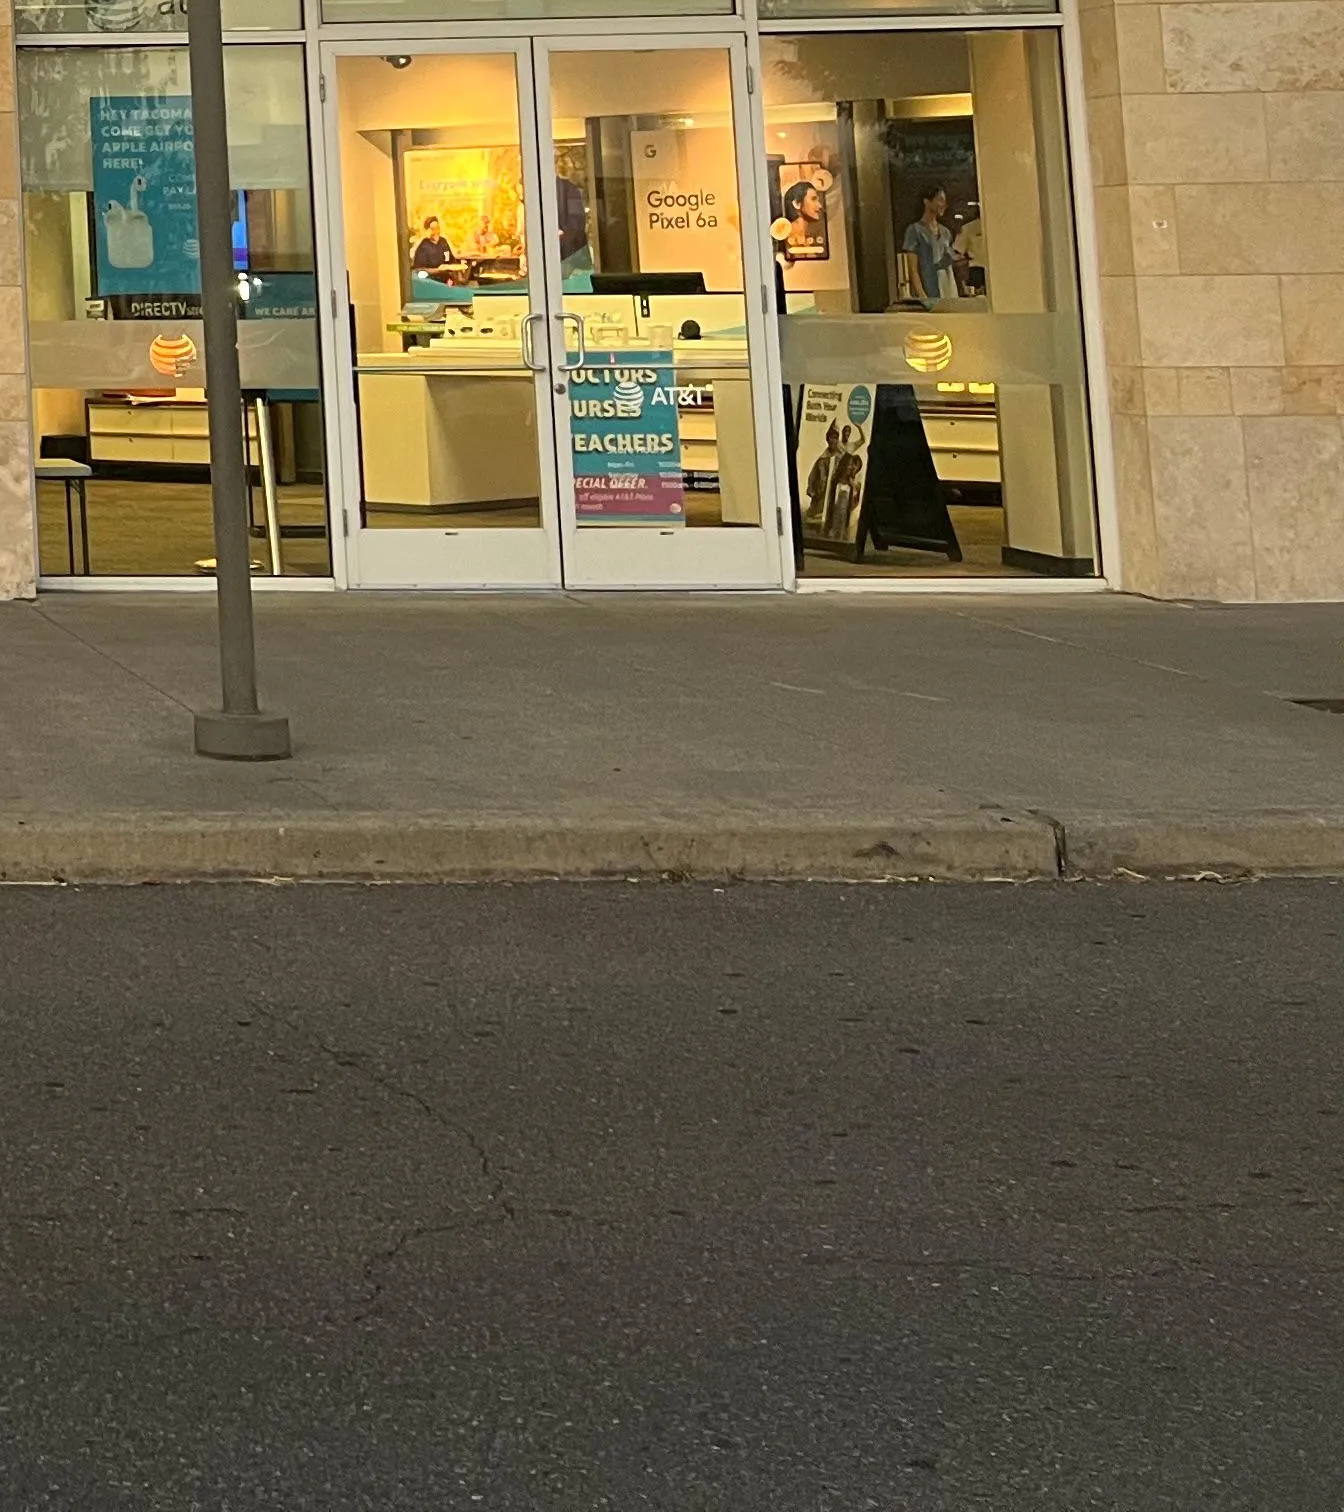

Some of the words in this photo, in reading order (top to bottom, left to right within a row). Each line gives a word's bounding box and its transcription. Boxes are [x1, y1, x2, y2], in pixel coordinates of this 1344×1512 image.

[175, 125, 195, 136] YO
[102, 142, 147, 153] APPLE
[150, 140, 194, 152] AIRPO
[647, 188, 716, 212] Google
[649, 211, 690, 230] Pixel
[696, 211, 718, 228] 6a
[131, 301, 187, 317] DIRECTV
[569, 368, 658, 385] OCTORS
[651, 385, 705, 406] AT&T
[570, 399, 642, 418] URSES
[571, 433, 675, 454] EACHERS
[573, 477, 607, 490] ECIAL
